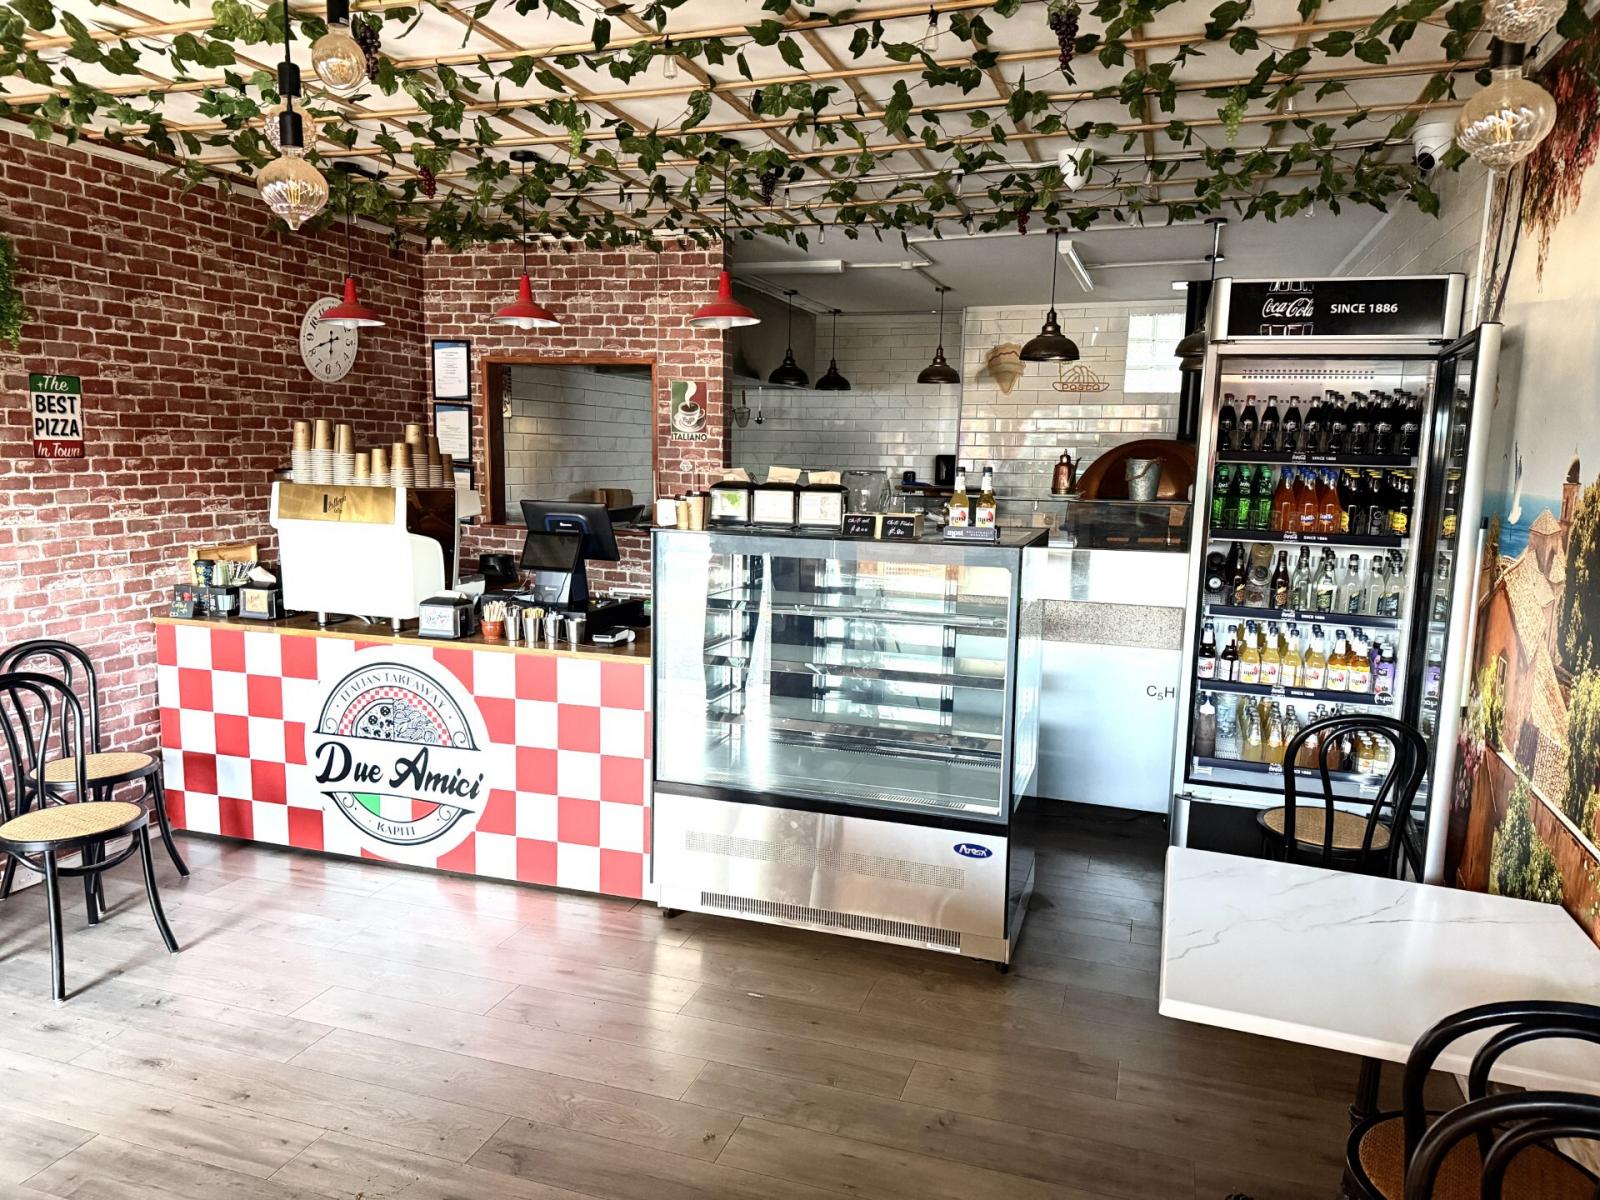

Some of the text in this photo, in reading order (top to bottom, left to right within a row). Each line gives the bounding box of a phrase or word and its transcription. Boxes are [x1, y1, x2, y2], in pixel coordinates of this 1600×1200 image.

[1261, 298, 1398, 318] Coca-Cola SINCE 1886
[42, 375, 69, 391] The
[35, 394, 77, 414] BEST
[35, 418, 80, 437] PIZZA
[672, 432, 708, 441] ITALIANO
[38, 442, 81, 457] In Town
[340, 671, 447, 709] ITALIAN TAKEAWAY
[315, 741, 484, 800] Due Amici
[376, 821, 416, 836] KAPITI
